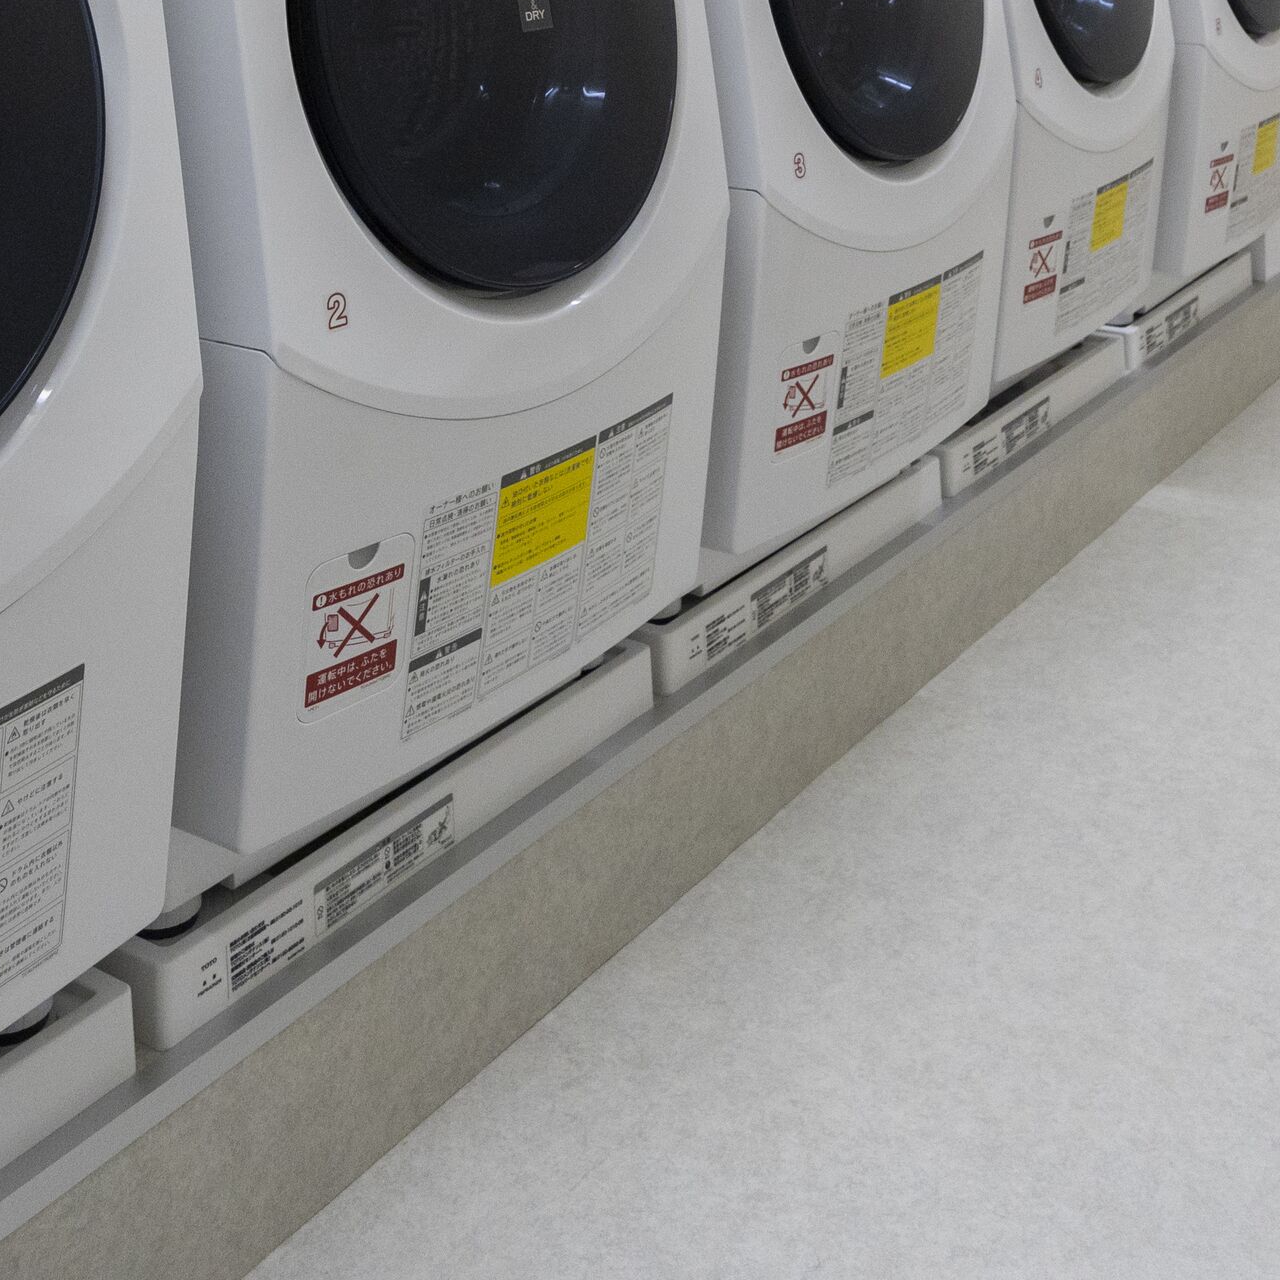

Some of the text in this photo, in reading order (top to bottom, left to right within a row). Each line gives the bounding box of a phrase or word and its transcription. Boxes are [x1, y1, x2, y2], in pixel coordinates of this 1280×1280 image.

[525, 8, 546, 22] DRY
[793, 152, 807, 179] 3
[326, 292, 349, 330] 2
[328, 567, 402, 604] 水もれの恐れあり
[308, 661, 395, 704] 開けないでください。
[317, 648, 388, 686] 運転中は、ふたを
